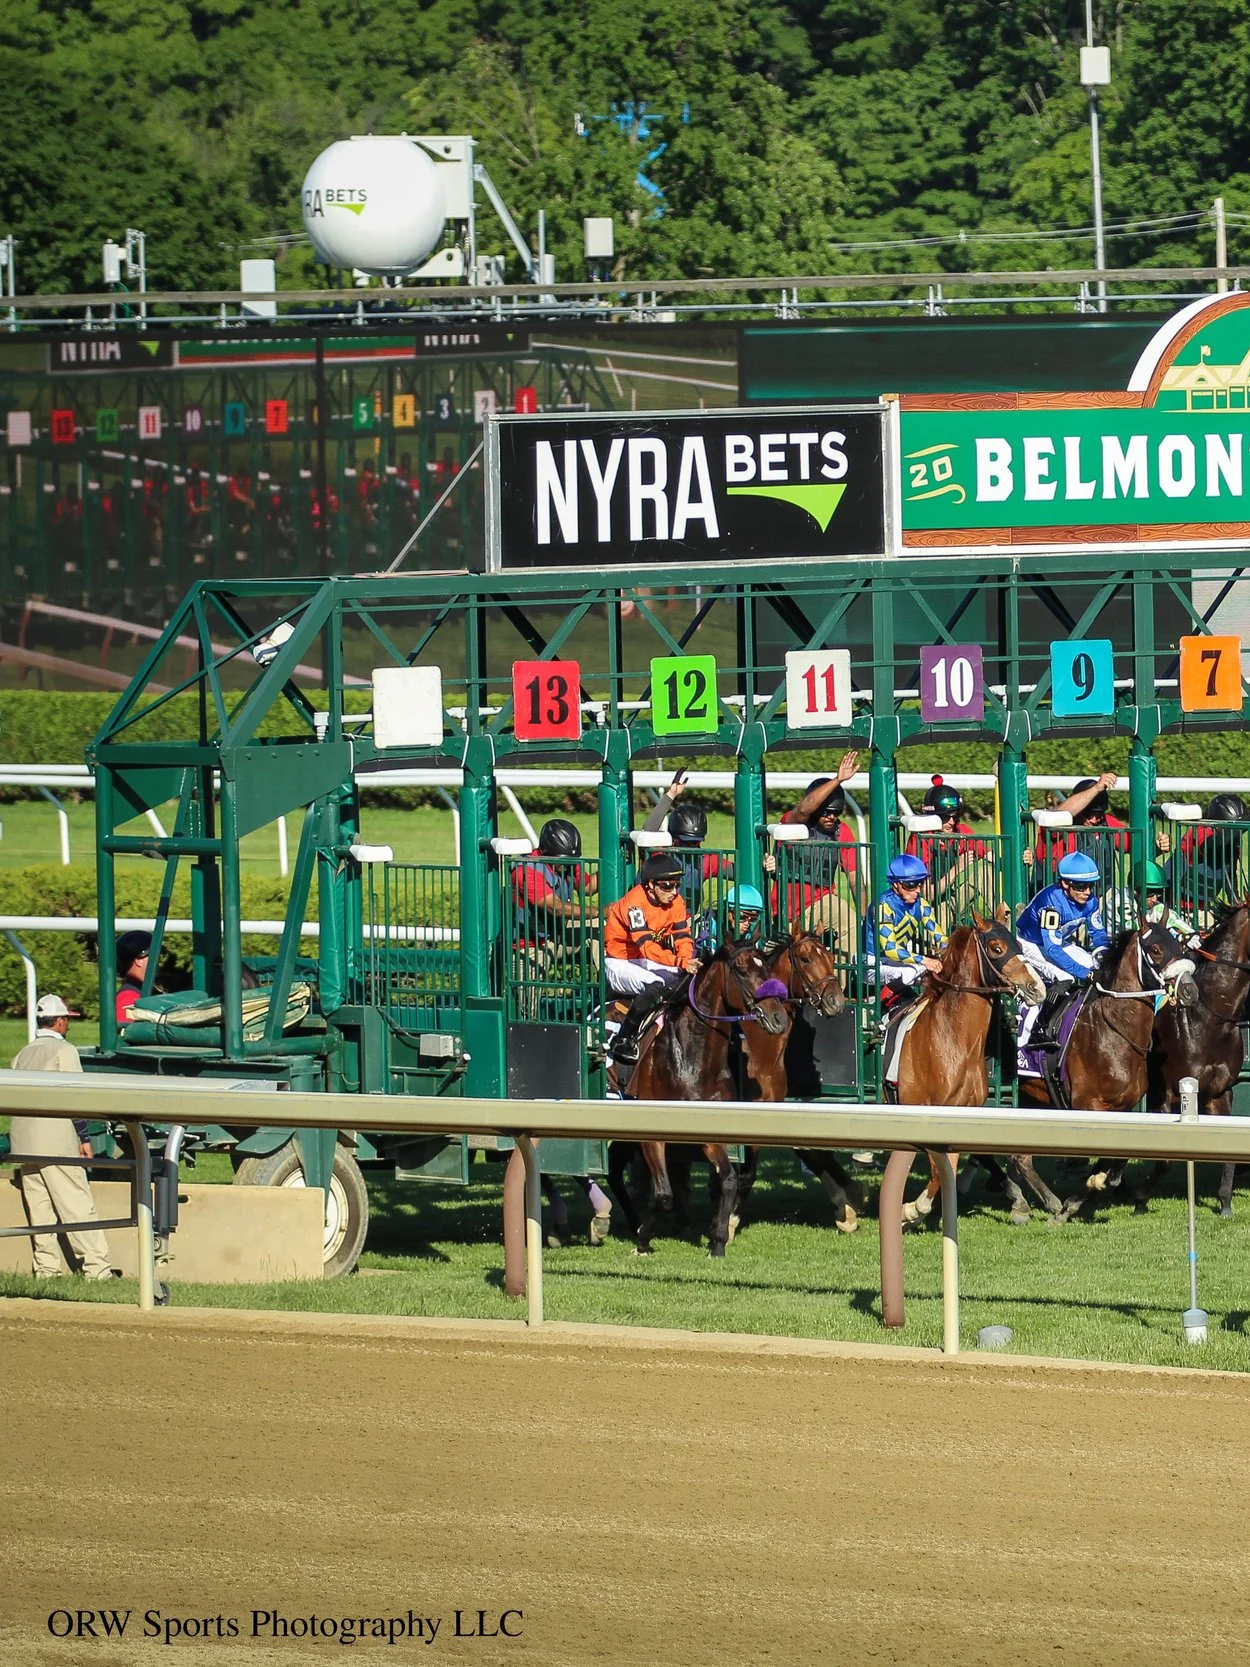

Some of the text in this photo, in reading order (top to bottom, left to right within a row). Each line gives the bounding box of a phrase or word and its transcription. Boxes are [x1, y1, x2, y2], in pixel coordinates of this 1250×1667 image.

[326, 189, 367, 202] BETS
[145, 414, 157, 434] 11
[185, 409, 201, 431] 10
[359, 404, 367, 423] 5
[400, 401, 408, 420] 4
[536, 431, 848, 545] NYRA BETS
[910, 456, 953, 487] 20
[802, 664, 838, 712] 11
[930, 657, 974, 708] 10
[1071, 653, 1095, 701] 9
[1200, 650, 1222, 697] 7
[526, 675, 569, 725] 13
[663, 669, 708, 719] 12
[1041, 909, 1060, 930] 10
